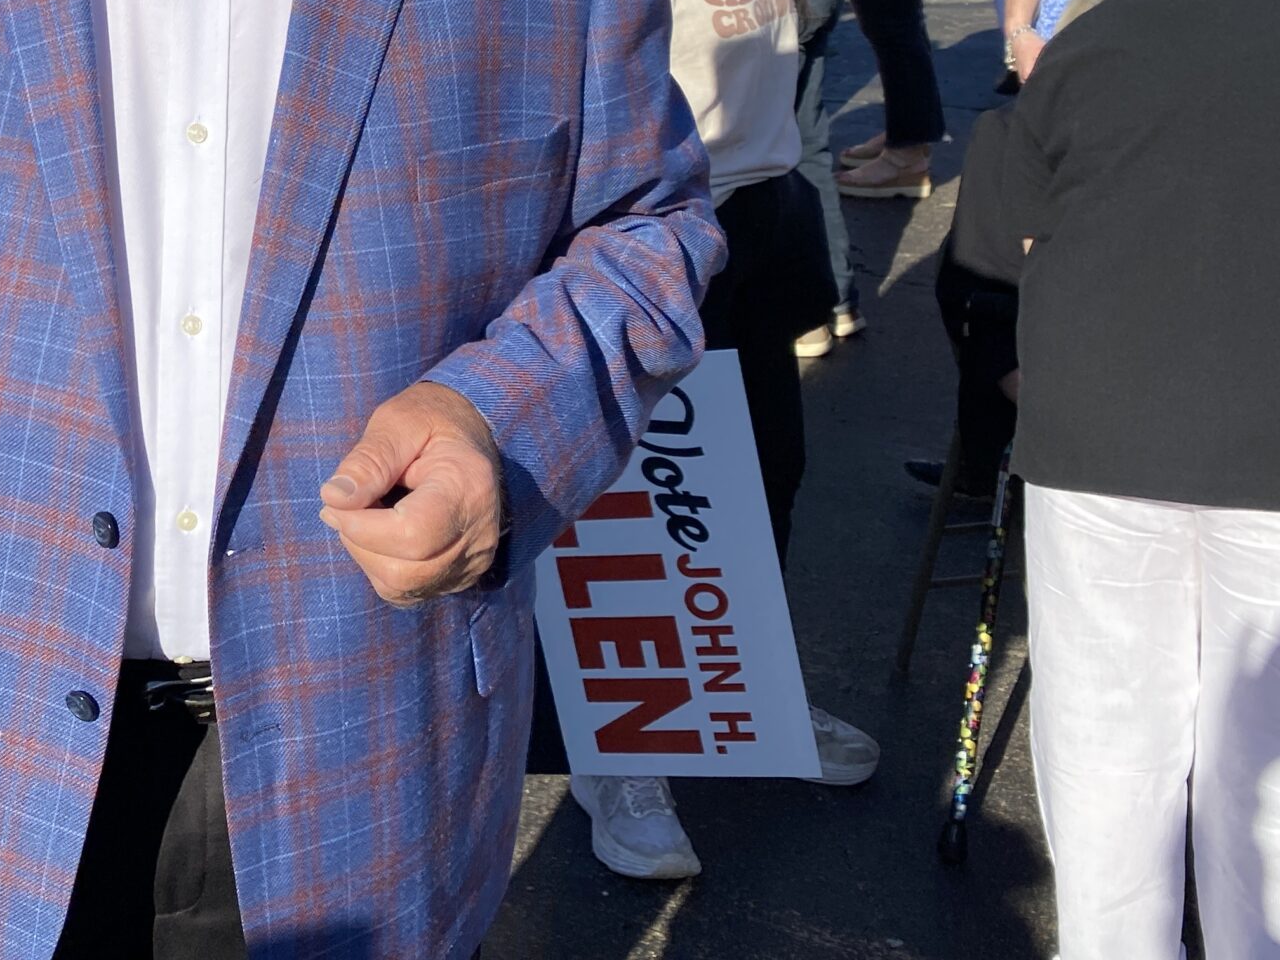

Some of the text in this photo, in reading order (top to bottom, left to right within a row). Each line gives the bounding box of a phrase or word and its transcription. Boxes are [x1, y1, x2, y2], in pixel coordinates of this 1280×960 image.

[553, 491, 705, 755] LLEN
[677, 553, 747, 693] JOHN
[709, 711, 757, 755] H.
